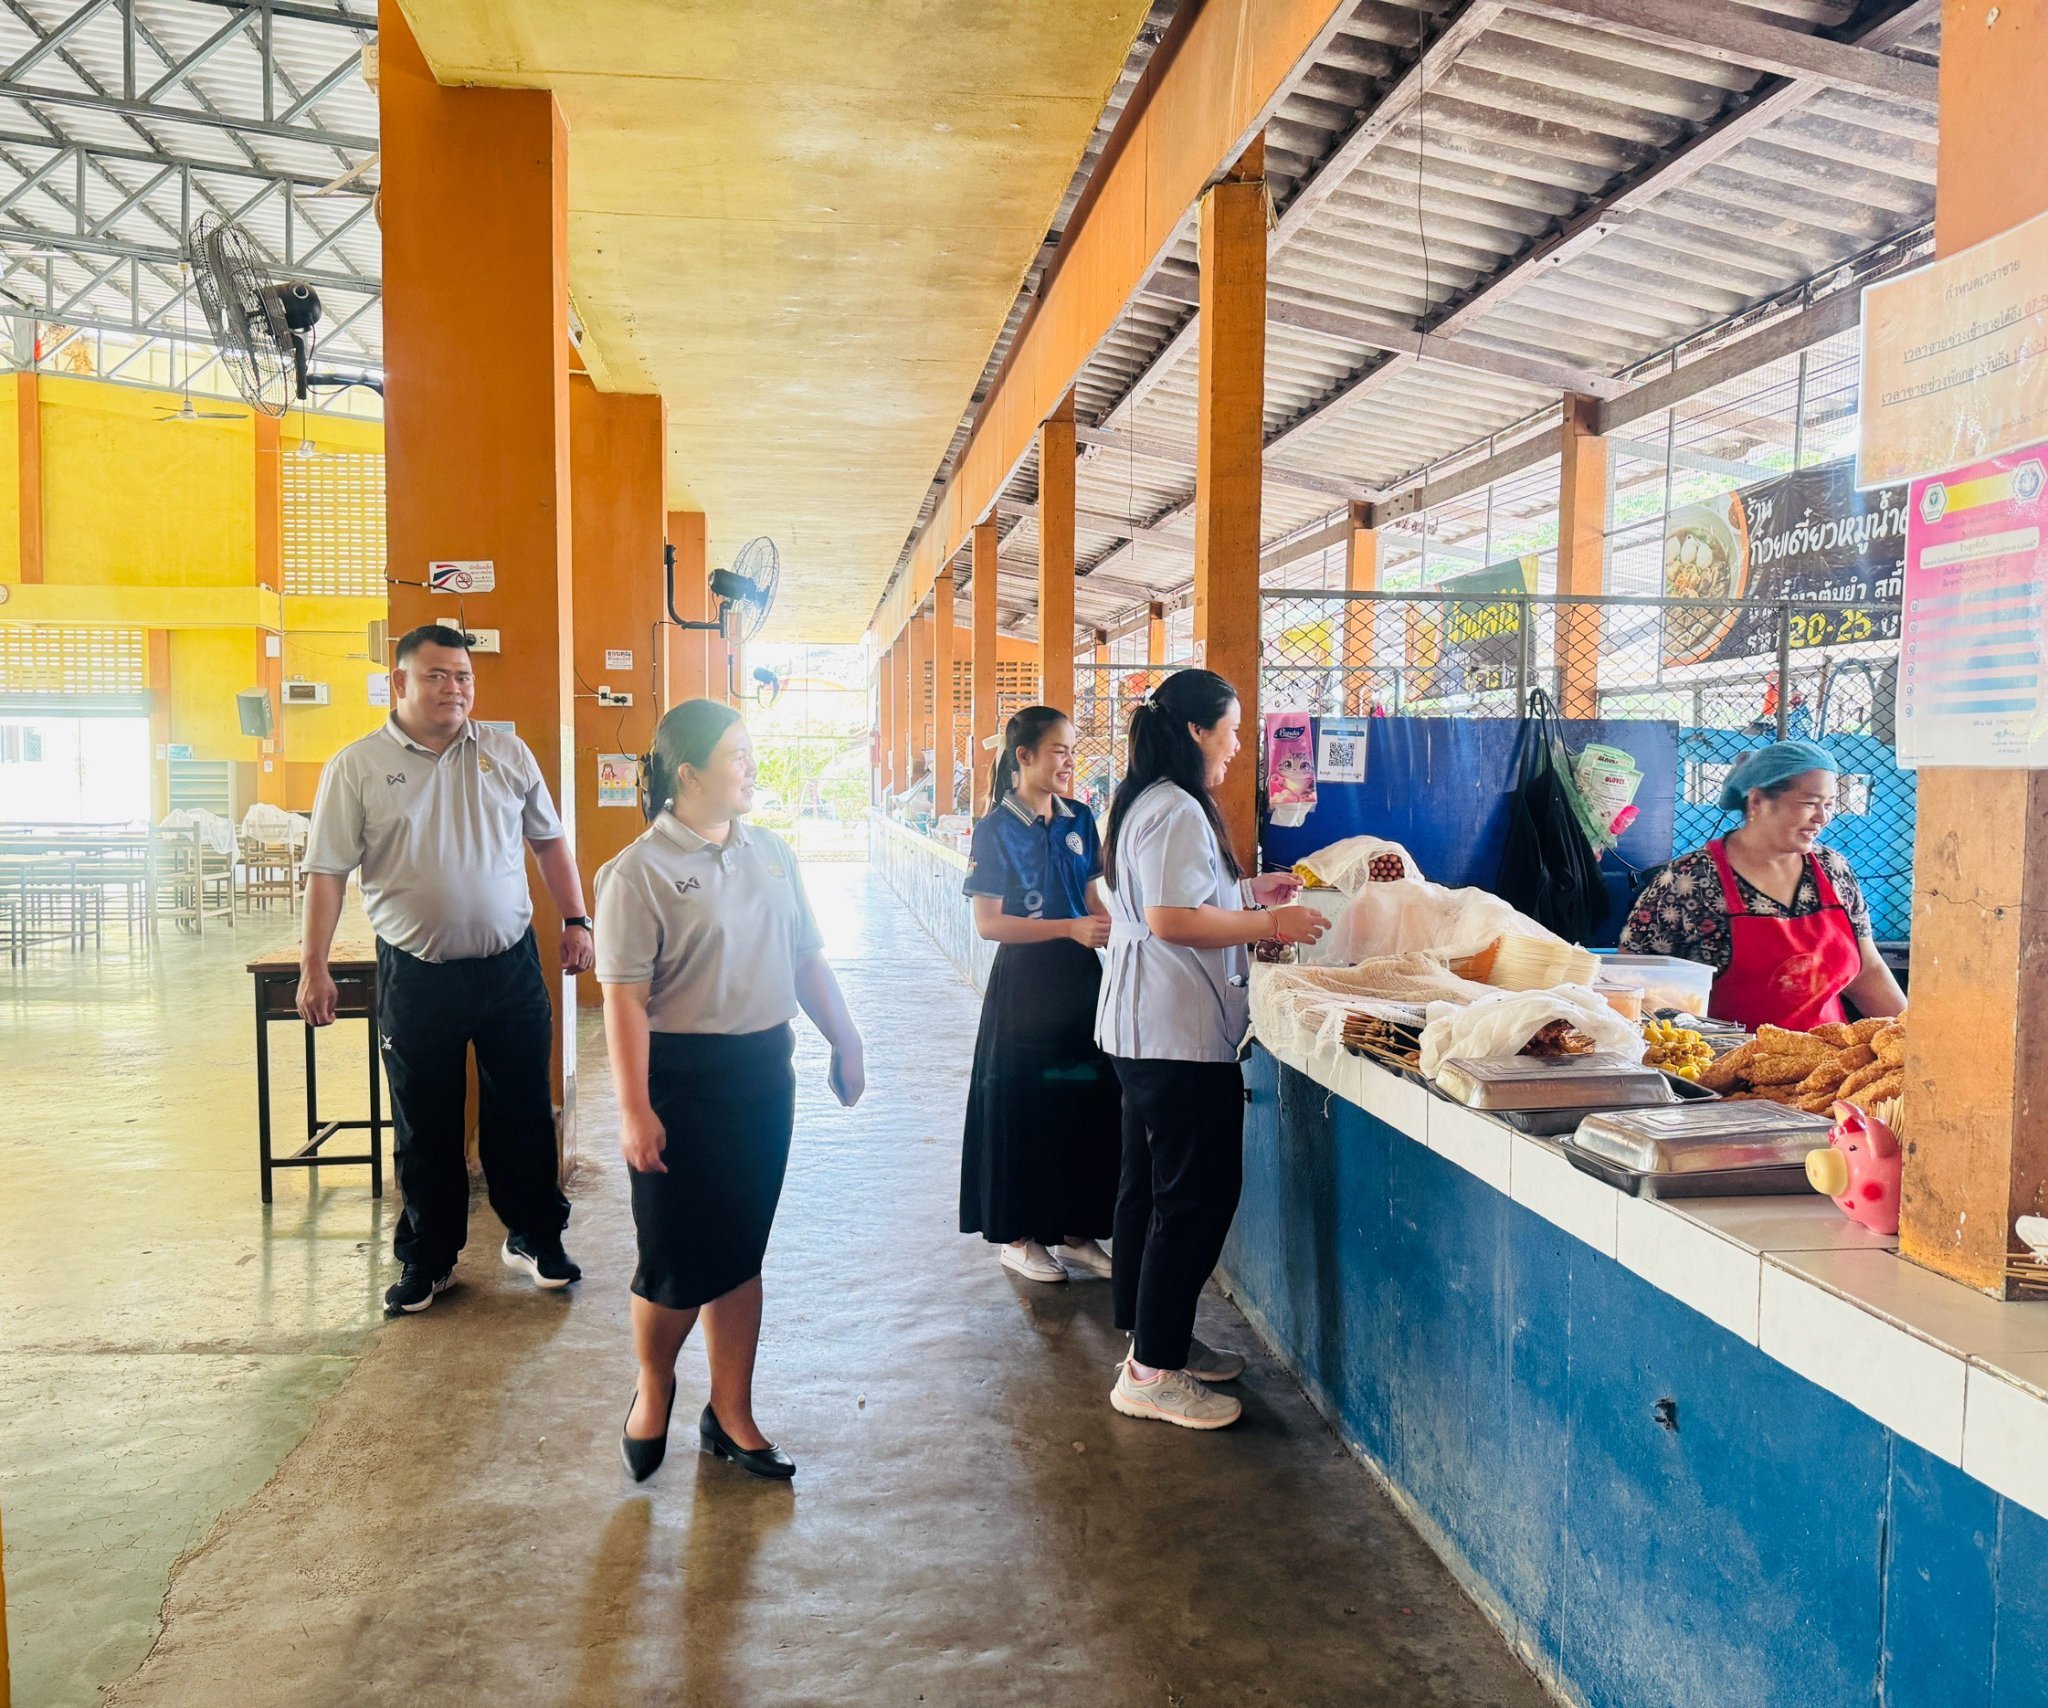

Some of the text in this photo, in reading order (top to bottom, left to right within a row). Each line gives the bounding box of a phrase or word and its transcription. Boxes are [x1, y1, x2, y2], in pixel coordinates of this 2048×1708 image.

[1945, 259, 2021, 300] กำหนดเวลาขาย
[1881, 353, 2010, 404] เวลาขายช่วงพักกลงวันถึง
[1747, 497, 1773, 524] ร้าน
[1605, 776, 1625, 784] GLOVES
